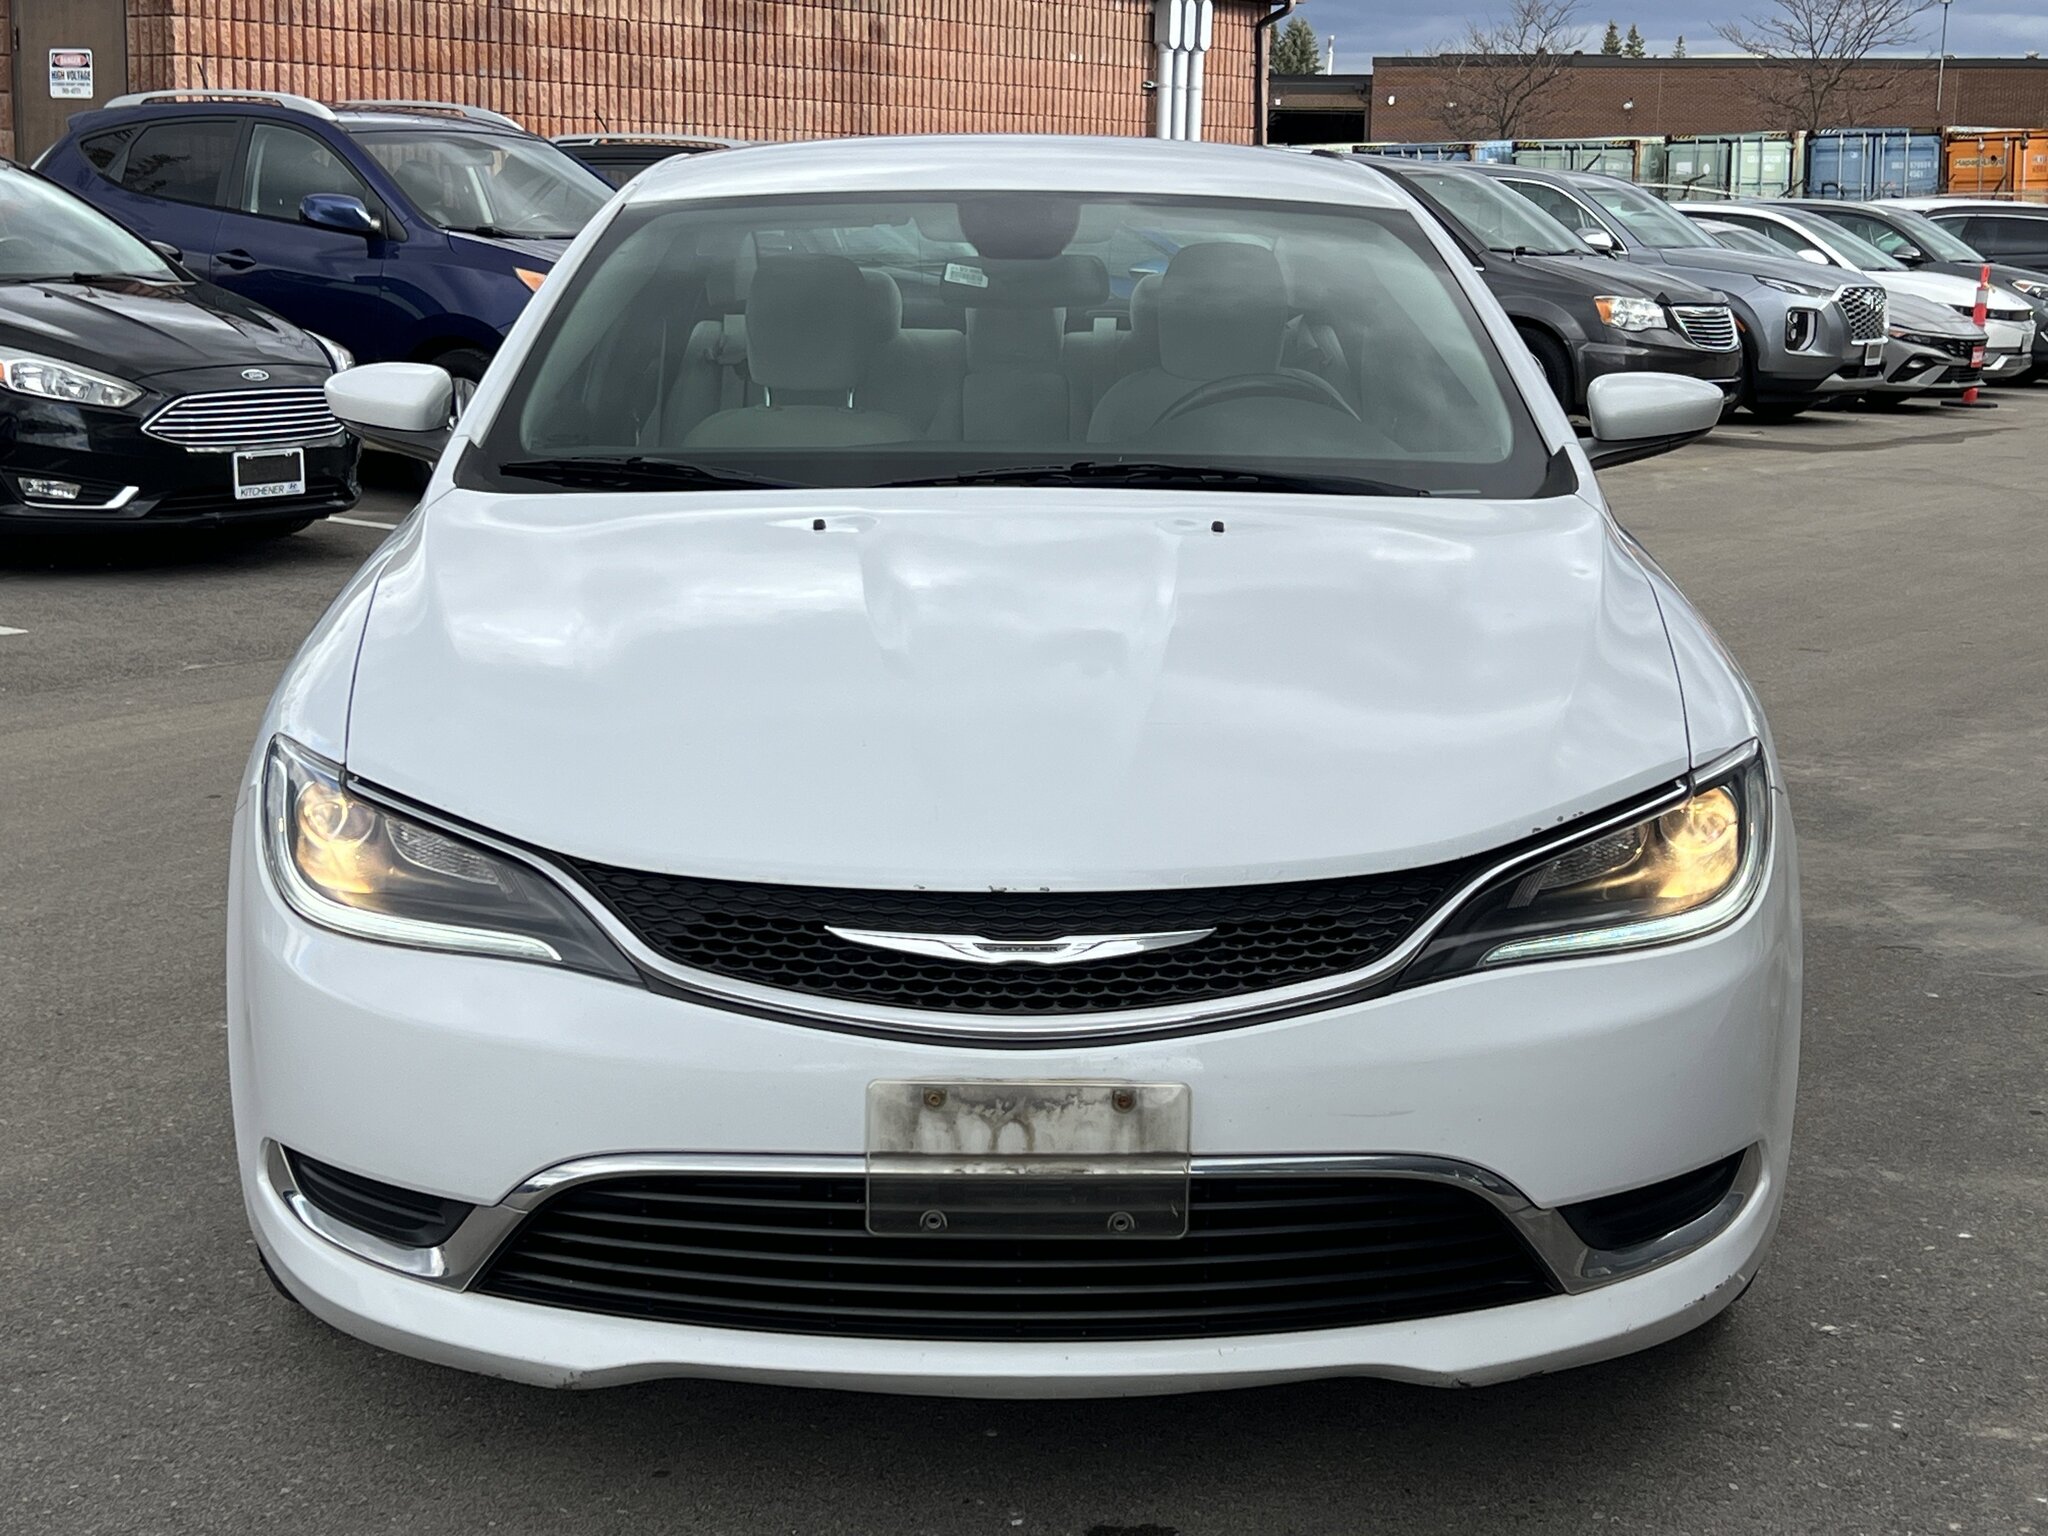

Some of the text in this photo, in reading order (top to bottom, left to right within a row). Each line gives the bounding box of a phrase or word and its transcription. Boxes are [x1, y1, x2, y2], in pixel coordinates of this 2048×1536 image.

[52, 70, 90, 80] HIGH VOLTAGE
[241, 485, 285, 497] KITCHENER
[983, 945, 1059, 953] CHRYSLER
